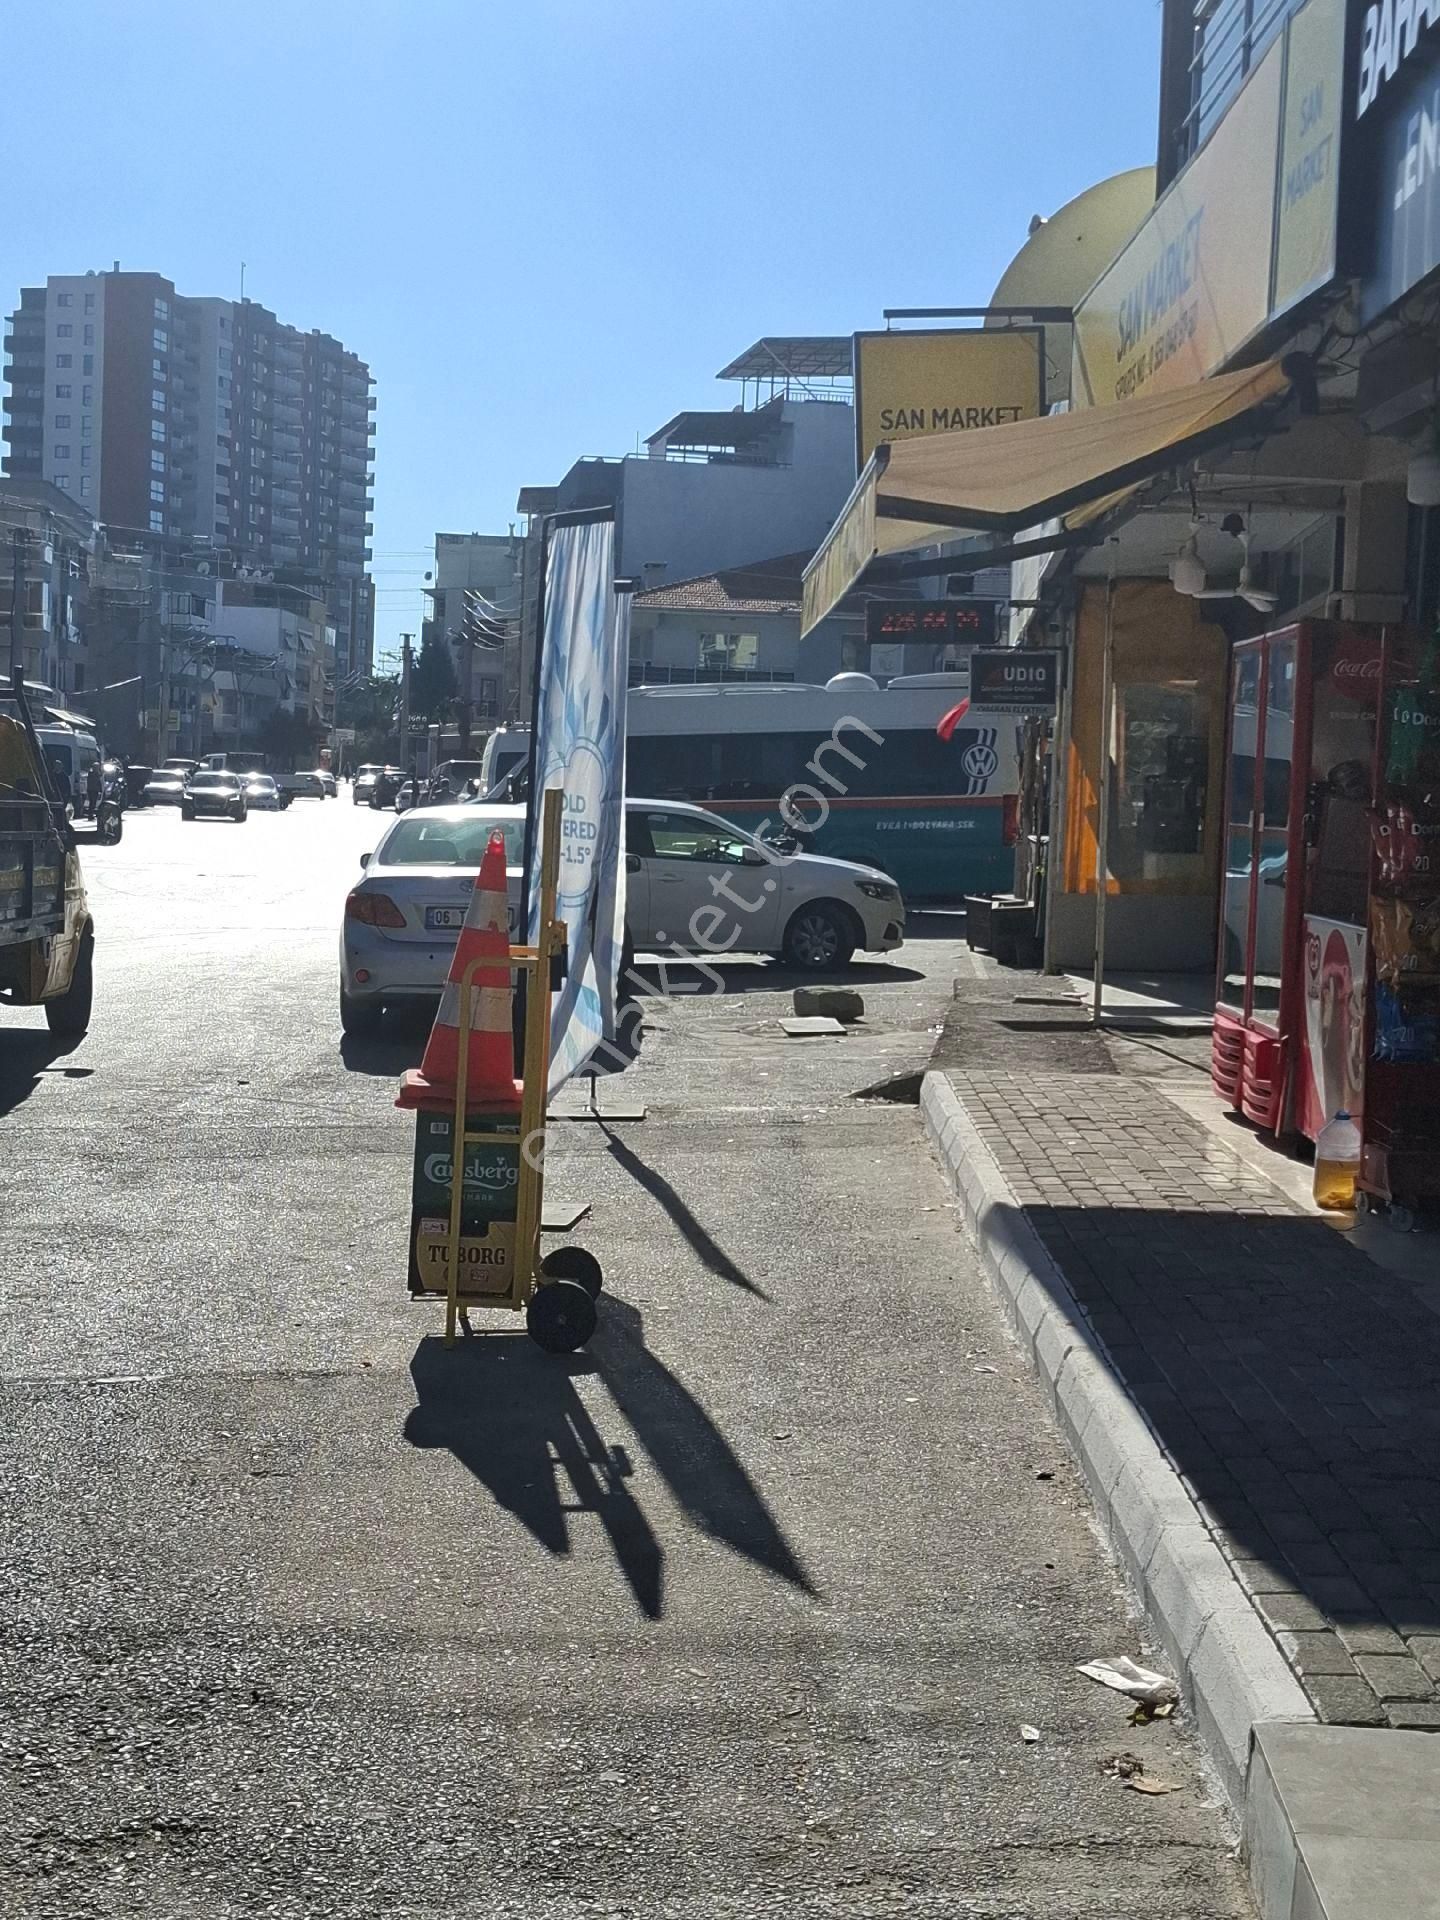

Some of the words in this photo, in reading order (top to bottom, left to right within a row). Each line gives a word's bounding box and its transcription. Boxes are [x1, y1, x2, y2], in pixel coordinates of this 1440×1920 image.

[880, 408, 925, 431] SAN
[932, 406, 1023, 429] MARKET
[562, 794, 586, 813] OLD
[563, 820, 598, 840] ERED
[435, 910, 450, 924] 06
